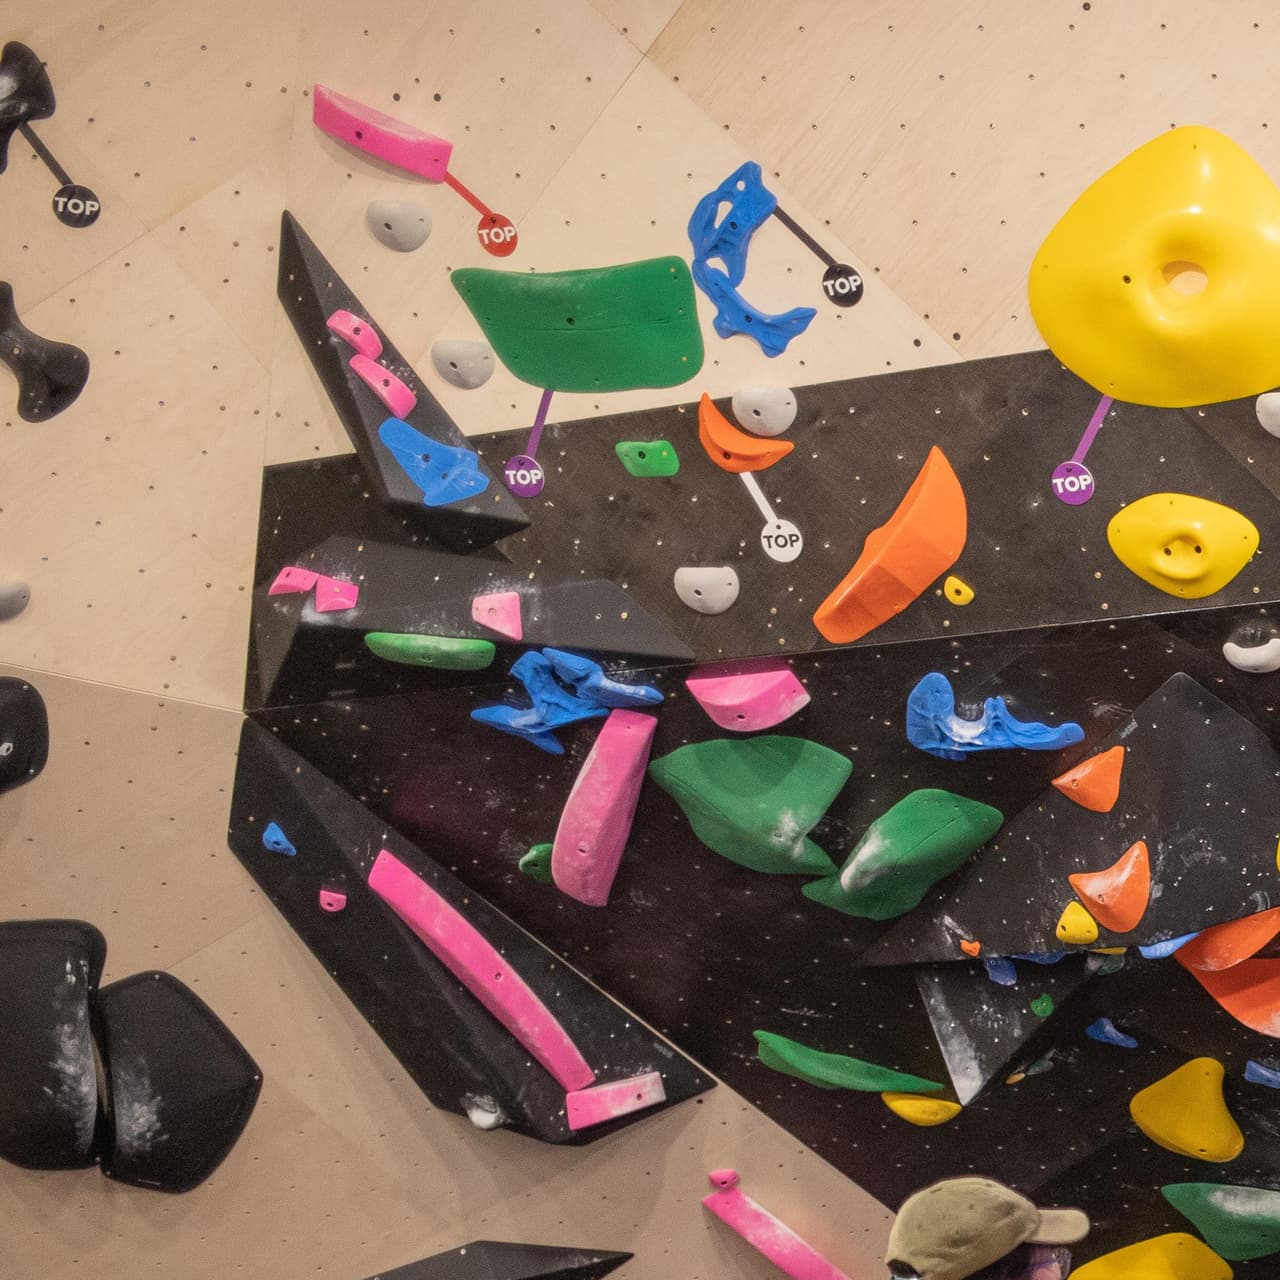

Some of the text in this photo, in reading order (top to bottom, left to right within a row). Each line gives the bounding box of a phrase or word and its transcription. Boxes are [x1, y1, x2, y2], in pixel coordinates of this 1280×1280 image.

[55, 197, 99, 215] TOP
[479, 225, 516, 244] TOP
[823, 277, 861, 295] TOP
[505, 469, 542, 486] TOP
[1052, 476, 1092, 493] TOP
[763, 534, 800, 549] TOP
